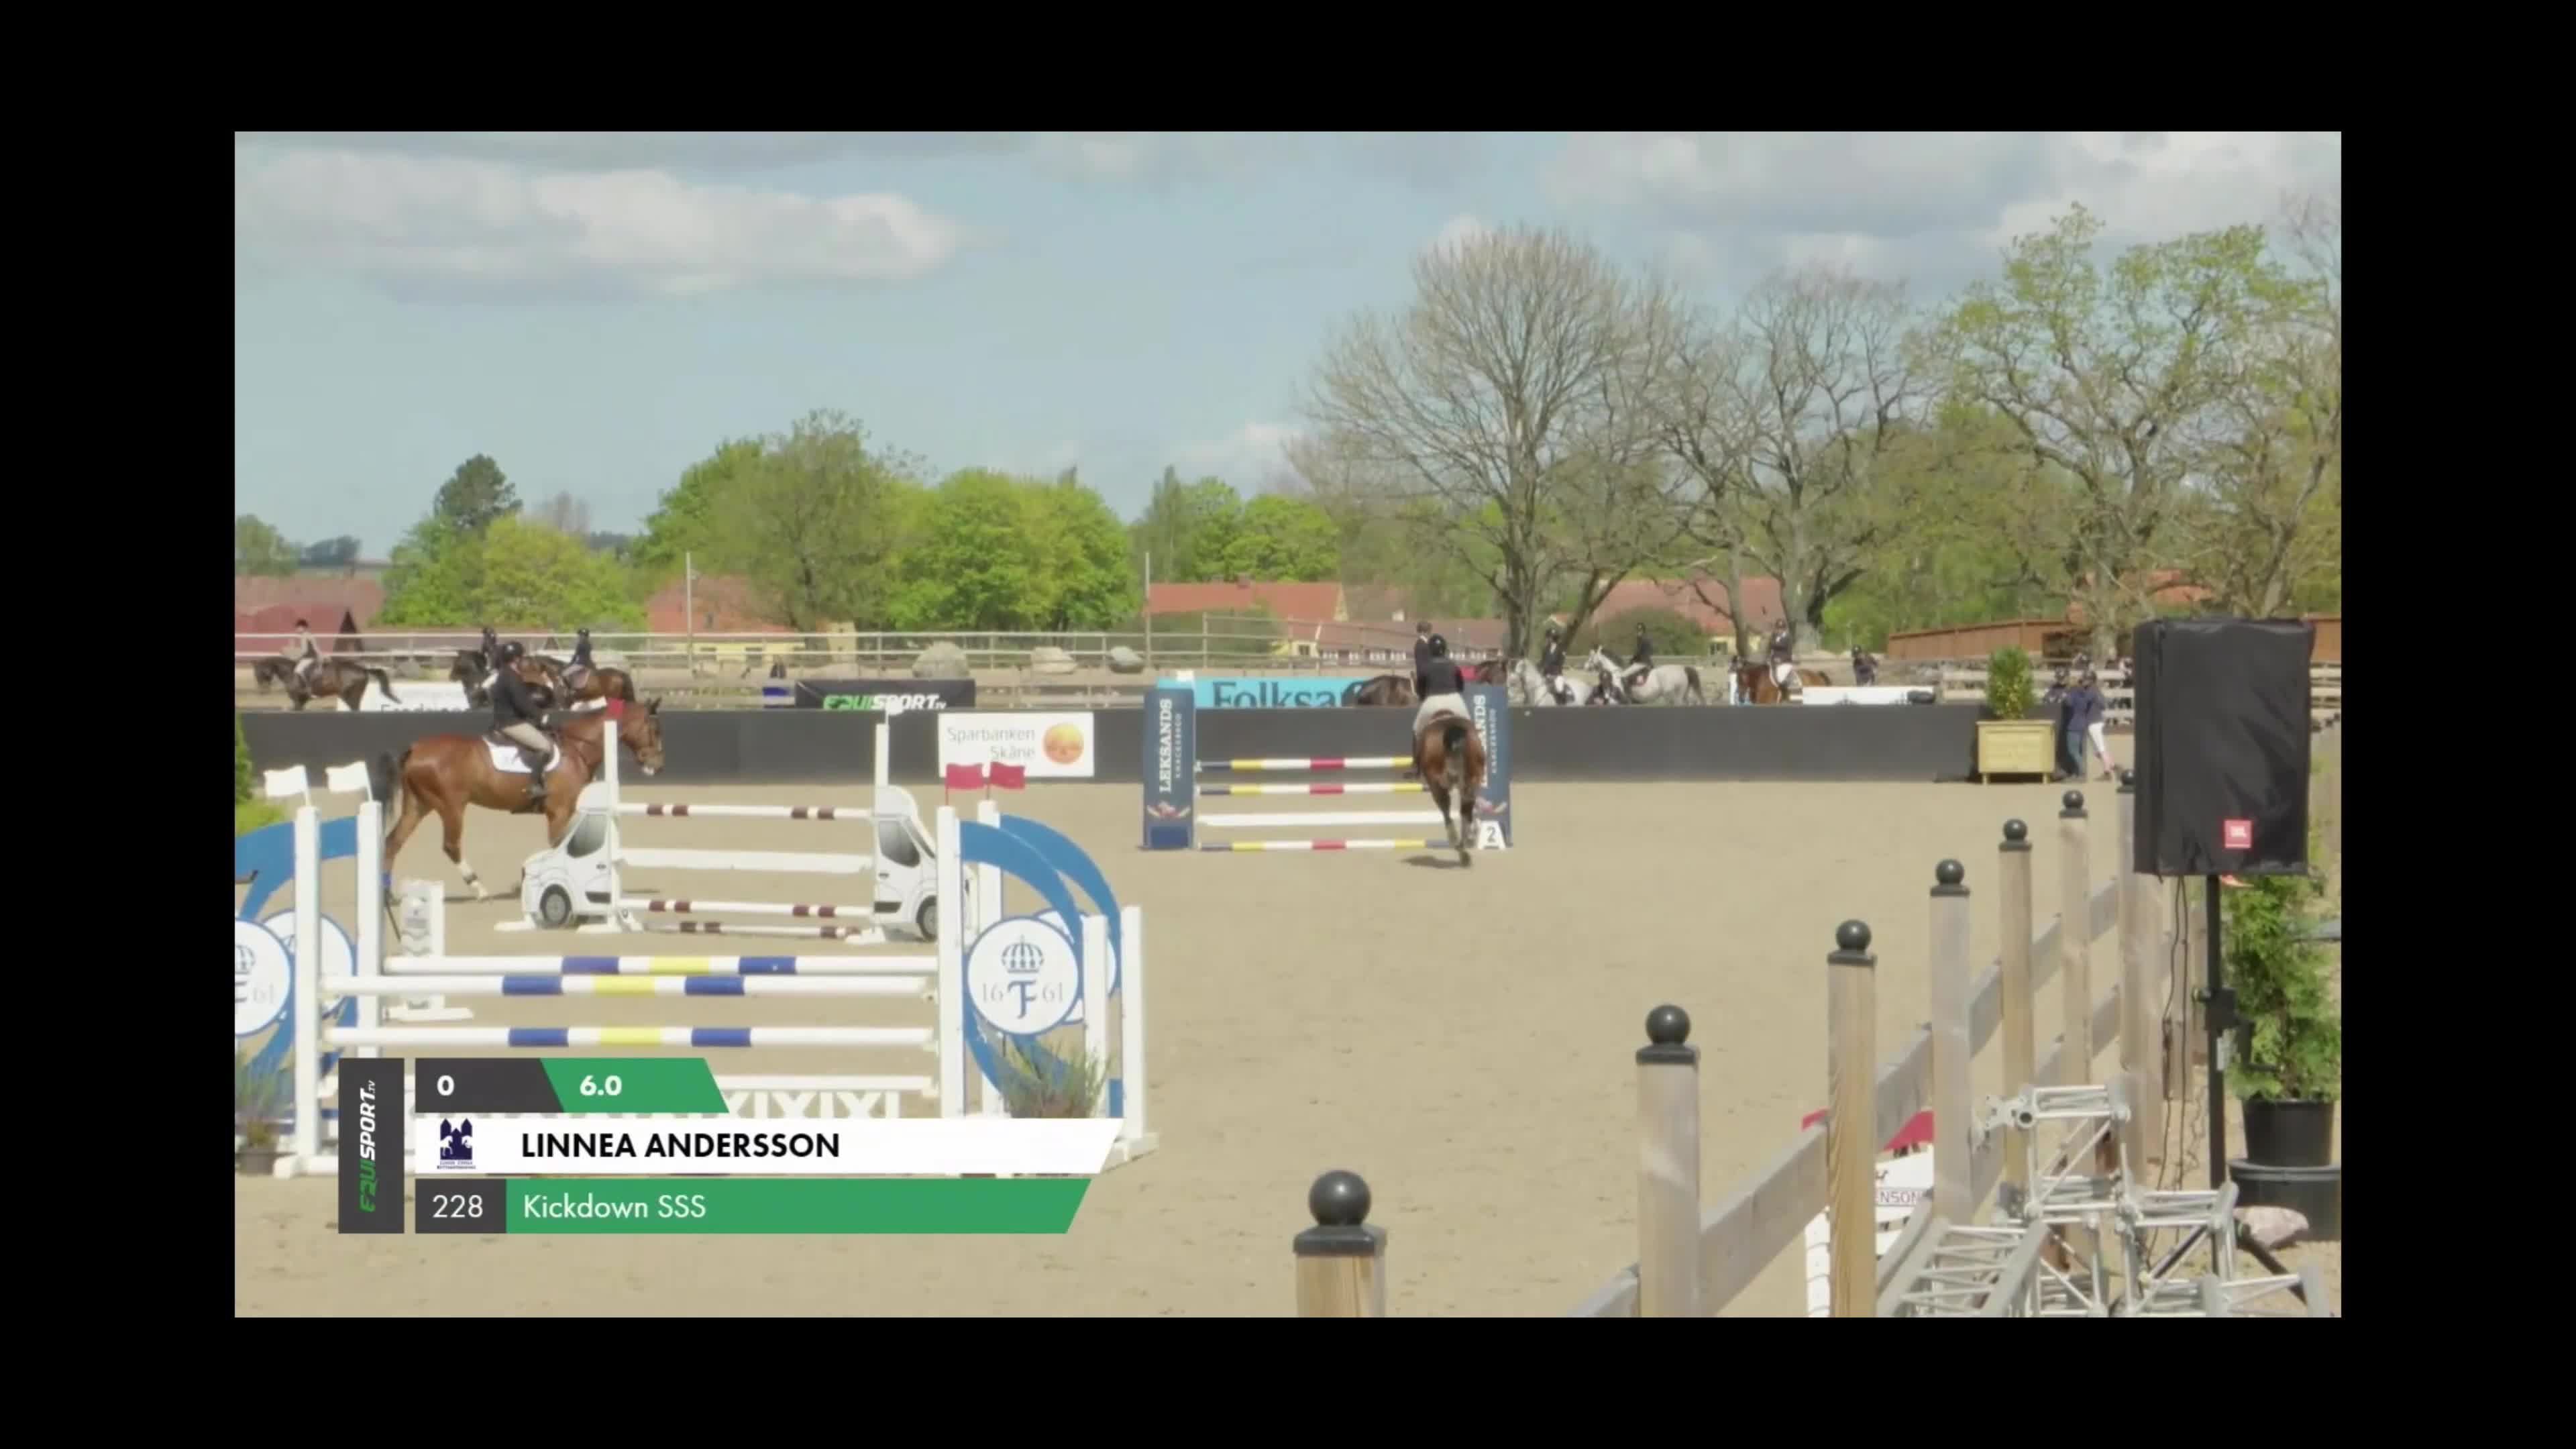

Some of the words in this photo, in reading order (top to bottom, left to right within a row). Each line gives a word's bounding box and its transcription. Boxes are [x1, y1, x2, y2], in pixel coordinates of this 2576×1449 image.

[1212, 681, 1347, 708] Folksa
[947, 727, 1035, 743] Sparbanken
[989, 745, 1035, 758] Skåne
[1159, 698, 1173, 793] LEKSANDS
[1486, 826, 1496, 843] 2
